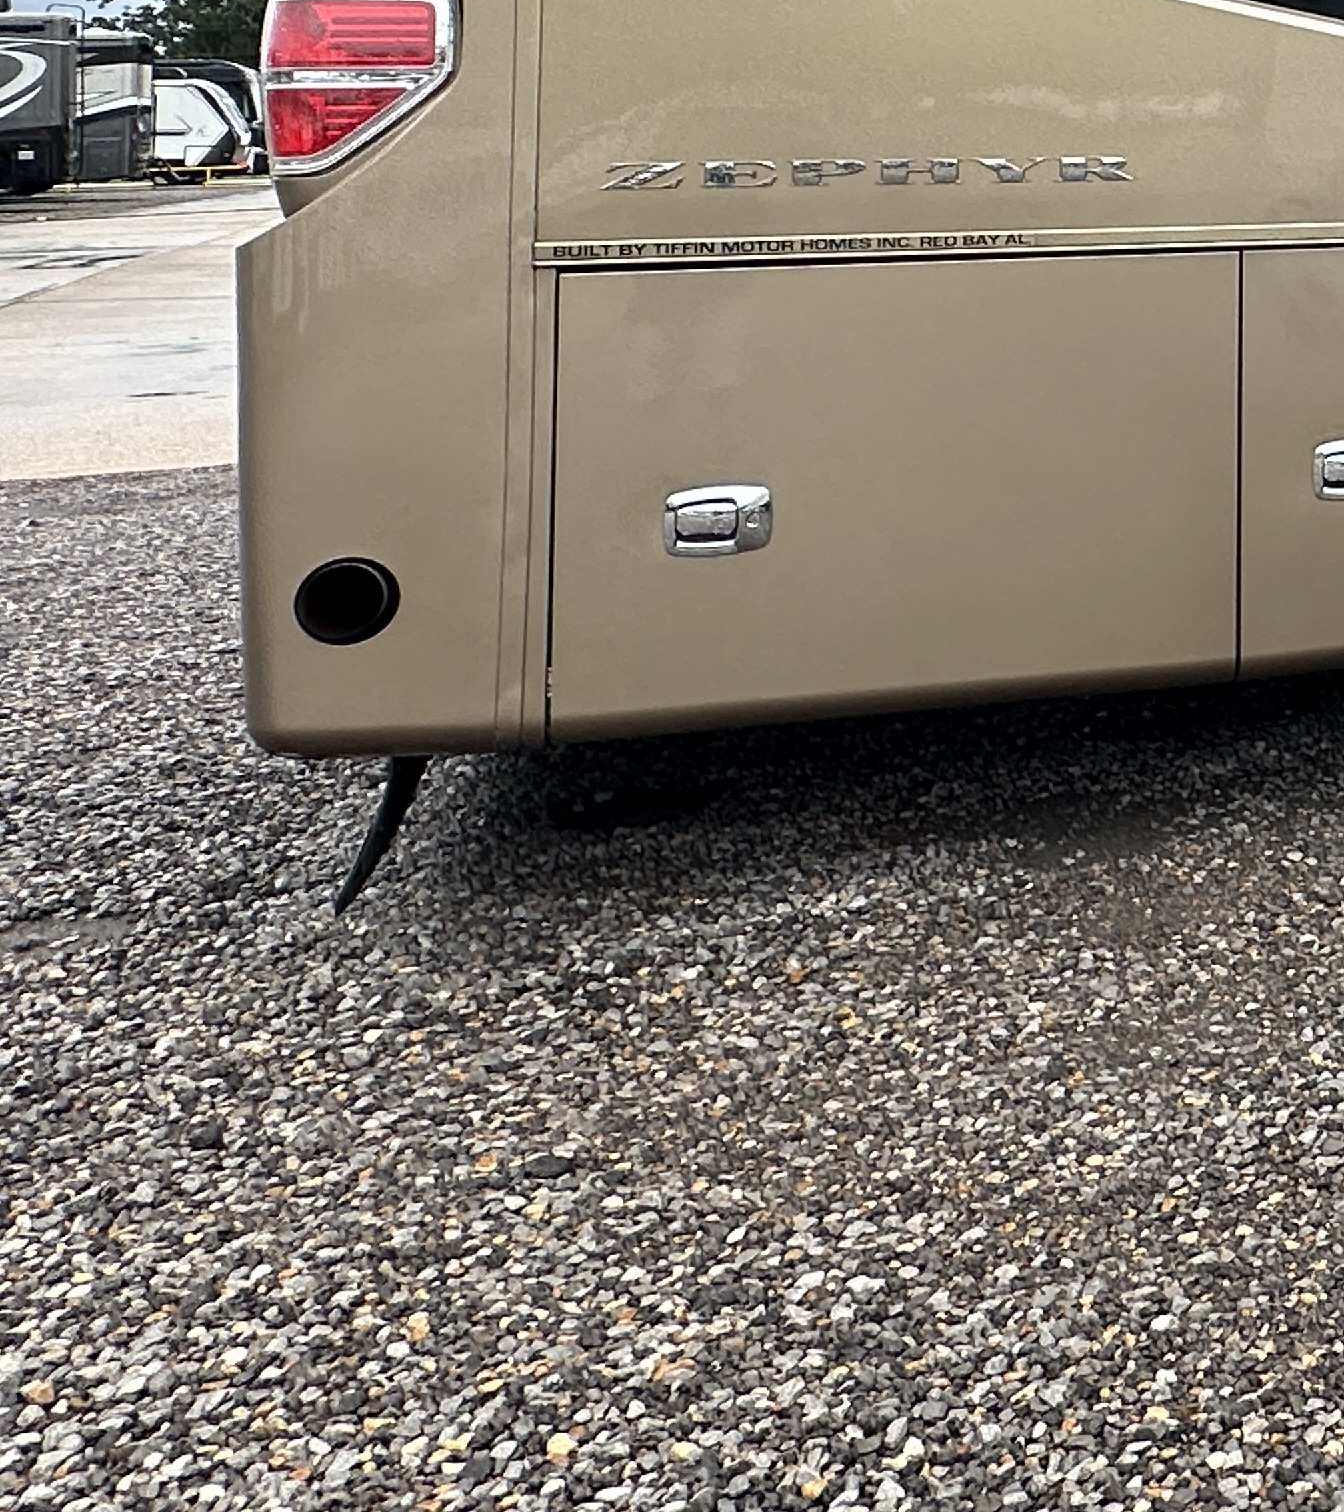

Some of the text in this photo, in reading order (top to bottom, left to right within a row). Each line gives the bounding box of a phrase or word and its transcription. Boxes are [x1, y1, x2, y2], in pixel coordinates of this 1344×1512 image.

[601, 157, 1134, 190] ZEPHYR
[553, 245, 612, 258] BUILT
[620, 244, 648, 256] BY
[654, 241, 715, 255] TIFFIN
[721, 240, 794, 254] MOTOR
[801, 238, 872, 252] HOMES
[919, 235, 958, 248] RED
[963, 234, 1001, 247] BAY
